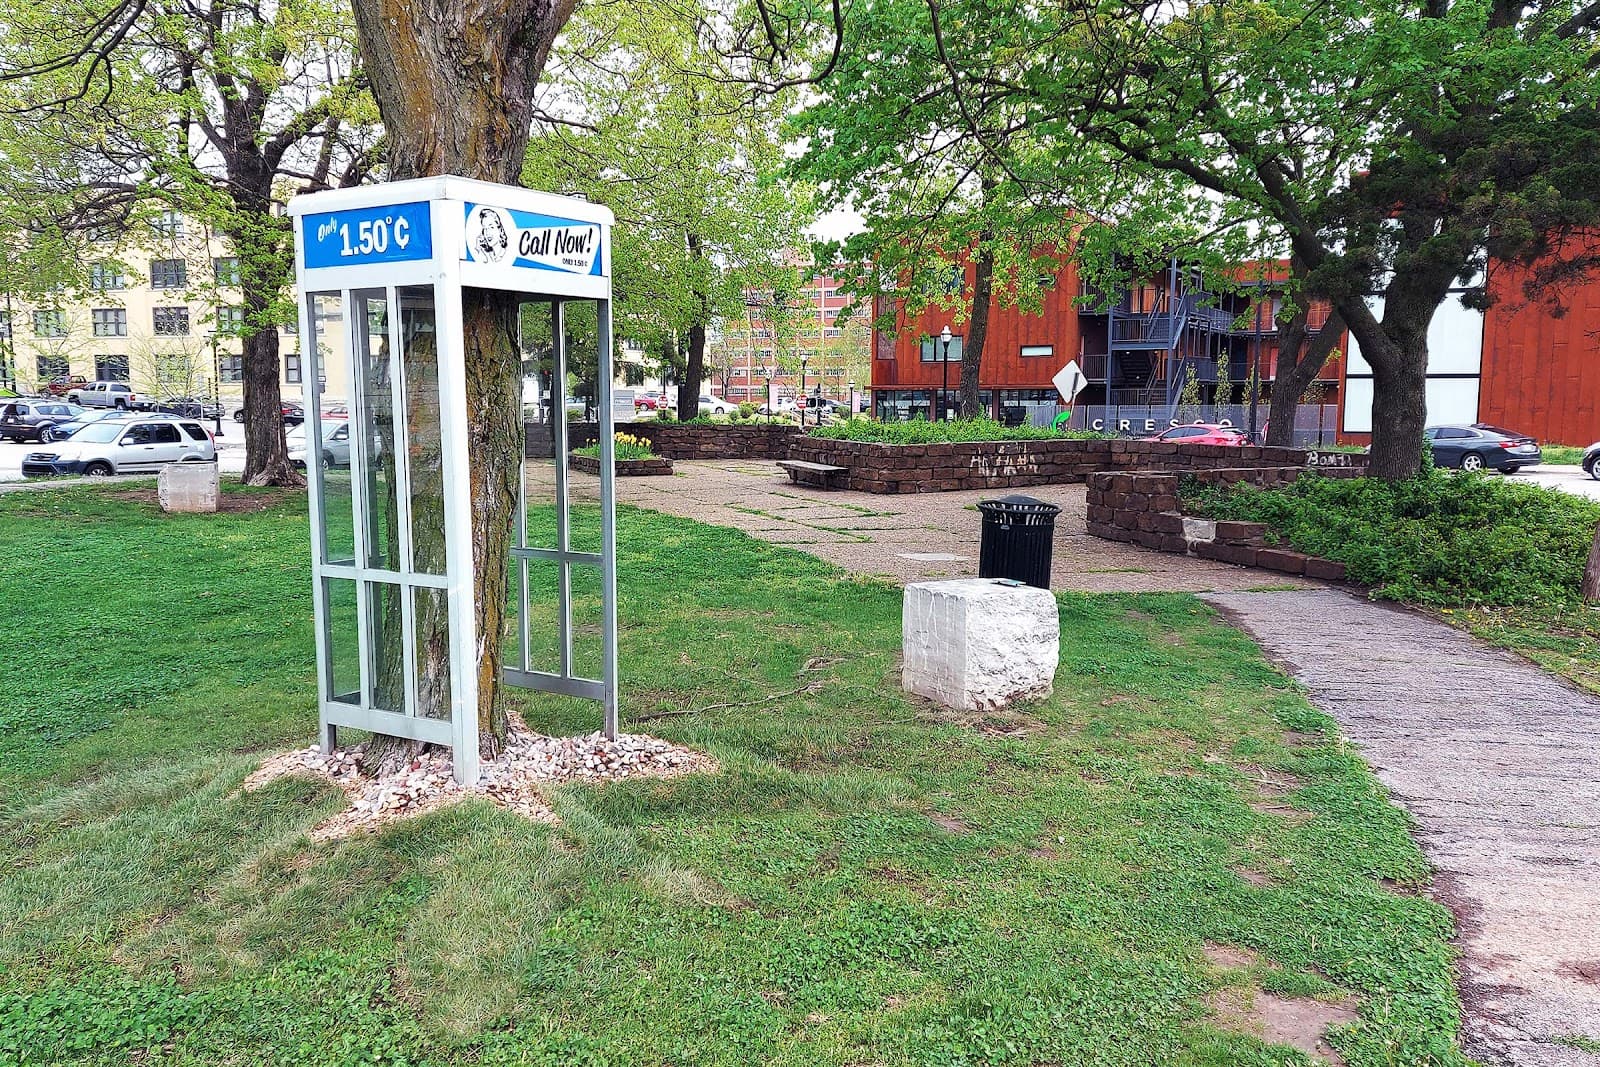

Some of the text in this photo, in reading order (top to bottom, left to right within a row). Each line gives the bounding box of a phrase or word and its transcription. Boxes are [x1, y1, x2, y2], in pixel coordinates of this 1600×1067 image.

[317, 216, 337, 242] Only
[519, 227, 593, 256] Call Now!
